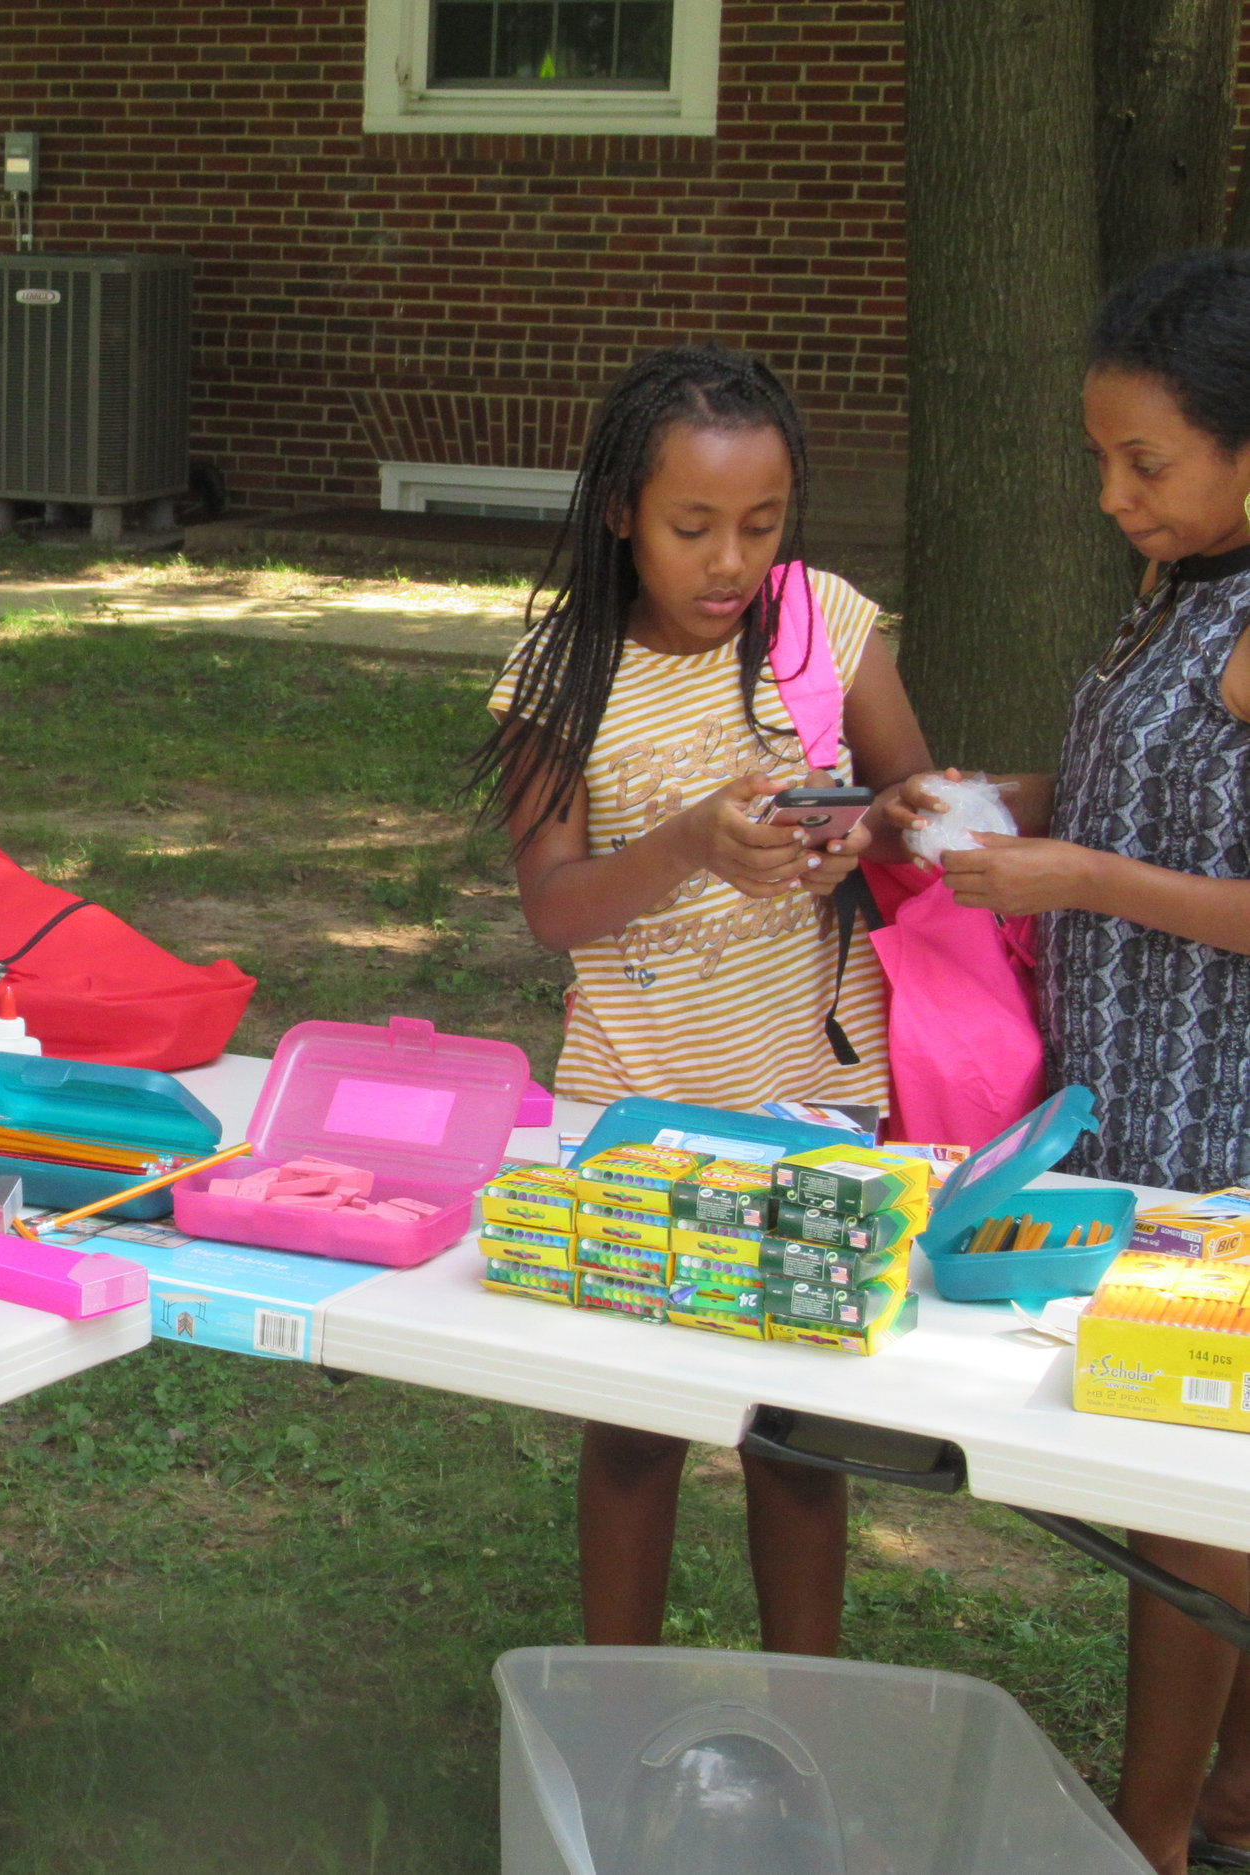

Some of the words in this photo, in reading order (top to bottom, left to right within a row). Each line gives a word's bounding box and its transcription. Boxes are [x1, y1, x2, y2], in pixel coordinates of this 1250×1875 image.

[1189, 1243, 1200, 1254] 12
[1188, 1349, 1209, 1362] 144
[1212, 1353, 1233, 1366] pcs
[1090, 1354, 1155, 1382] iScholar
[1087, 1390, 1103, 1398] HB
[1107, 1390, 1116, 1400] 2
[1120, 1394, 1159, 1406] PENCIL
